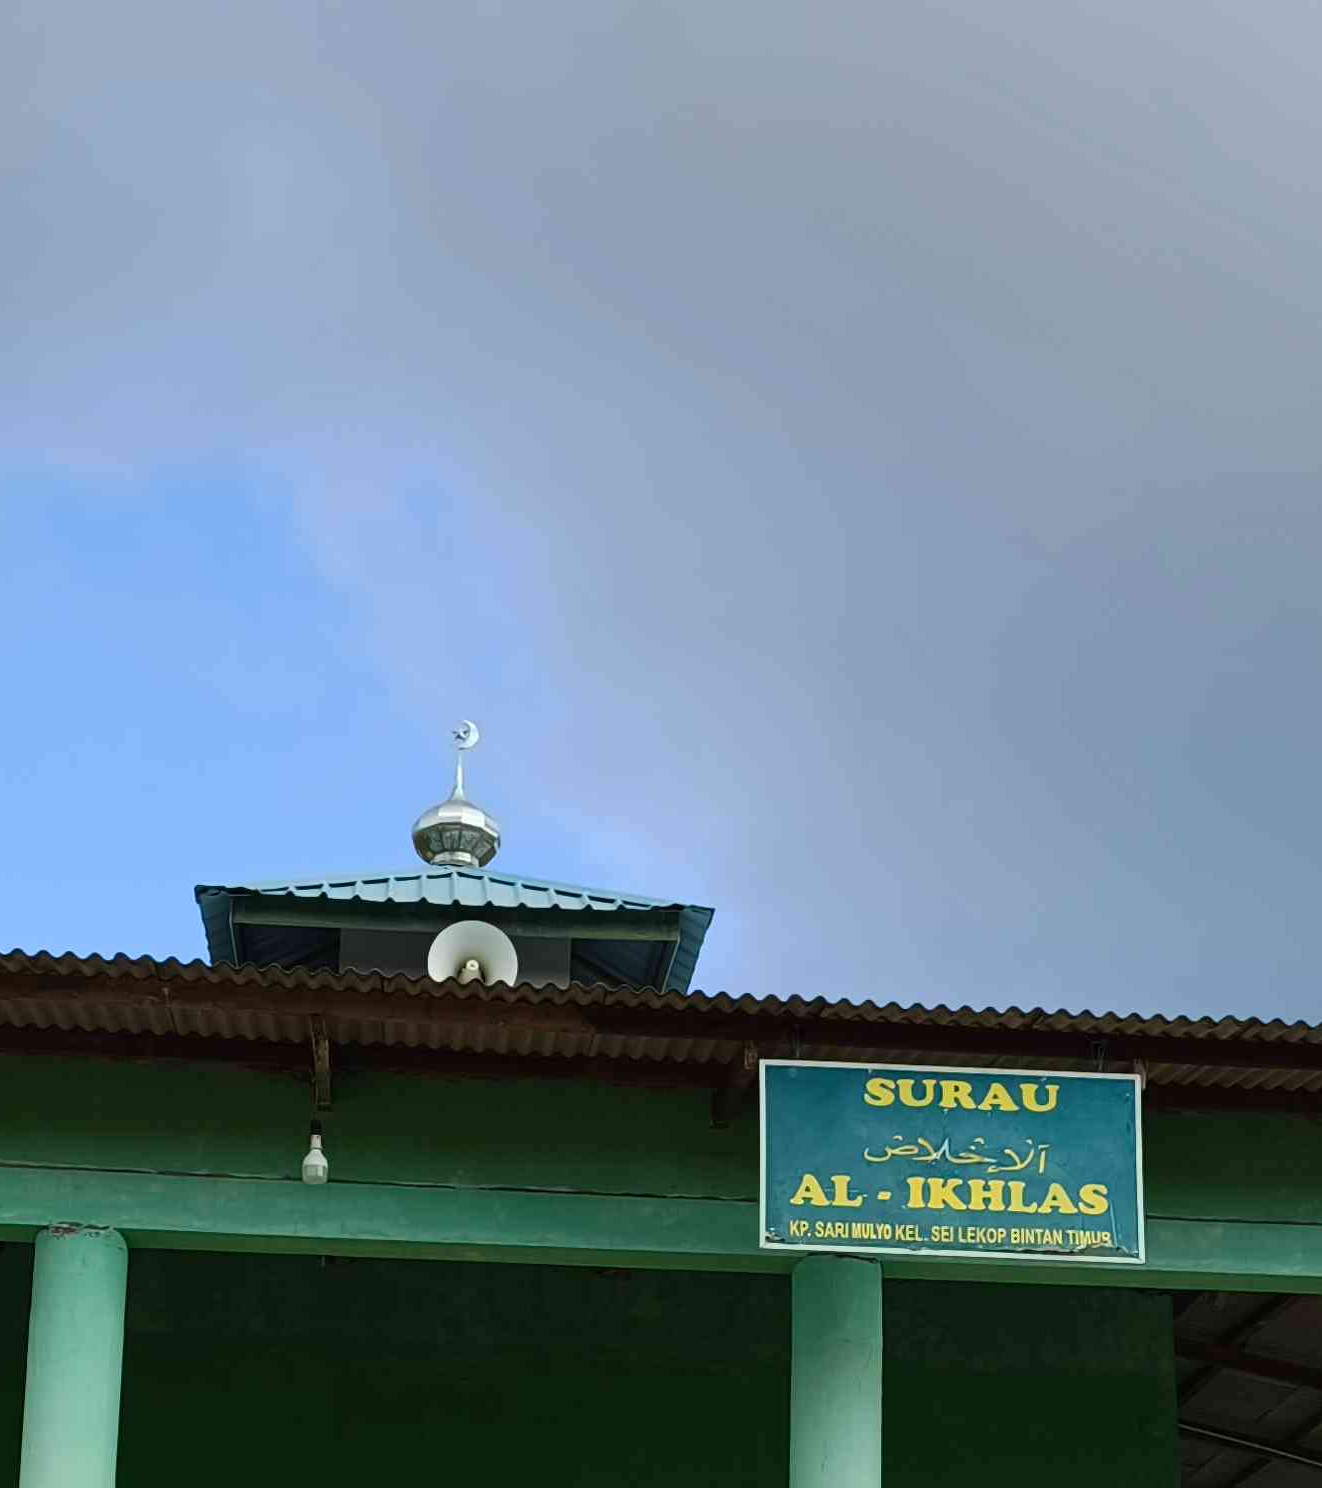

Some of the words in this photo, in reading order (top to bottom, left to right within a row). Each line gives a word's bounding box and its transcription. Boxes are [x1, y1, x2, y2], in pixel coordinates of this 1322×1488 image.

[863, 1077, 1060, 1112] SURAU
[789, 1173, 864, 1207] AL
[905, 1176, 1109, 1215] IKHLAS
[788, 1219, 811, 1237] KP.
[814, 1220, 850, 1239] SARI
[851, 1221, 892, 1240] MULYO
[895, 1223, 929, 1242] KEL.
[931, 1225, 955, 1242] SEI
[957, 1226, 1007, 1244] LEKOP
[1010, 1227, 1063, 1245] BINTAN
[1065, 1229, 1114, 1247] TIMUR
